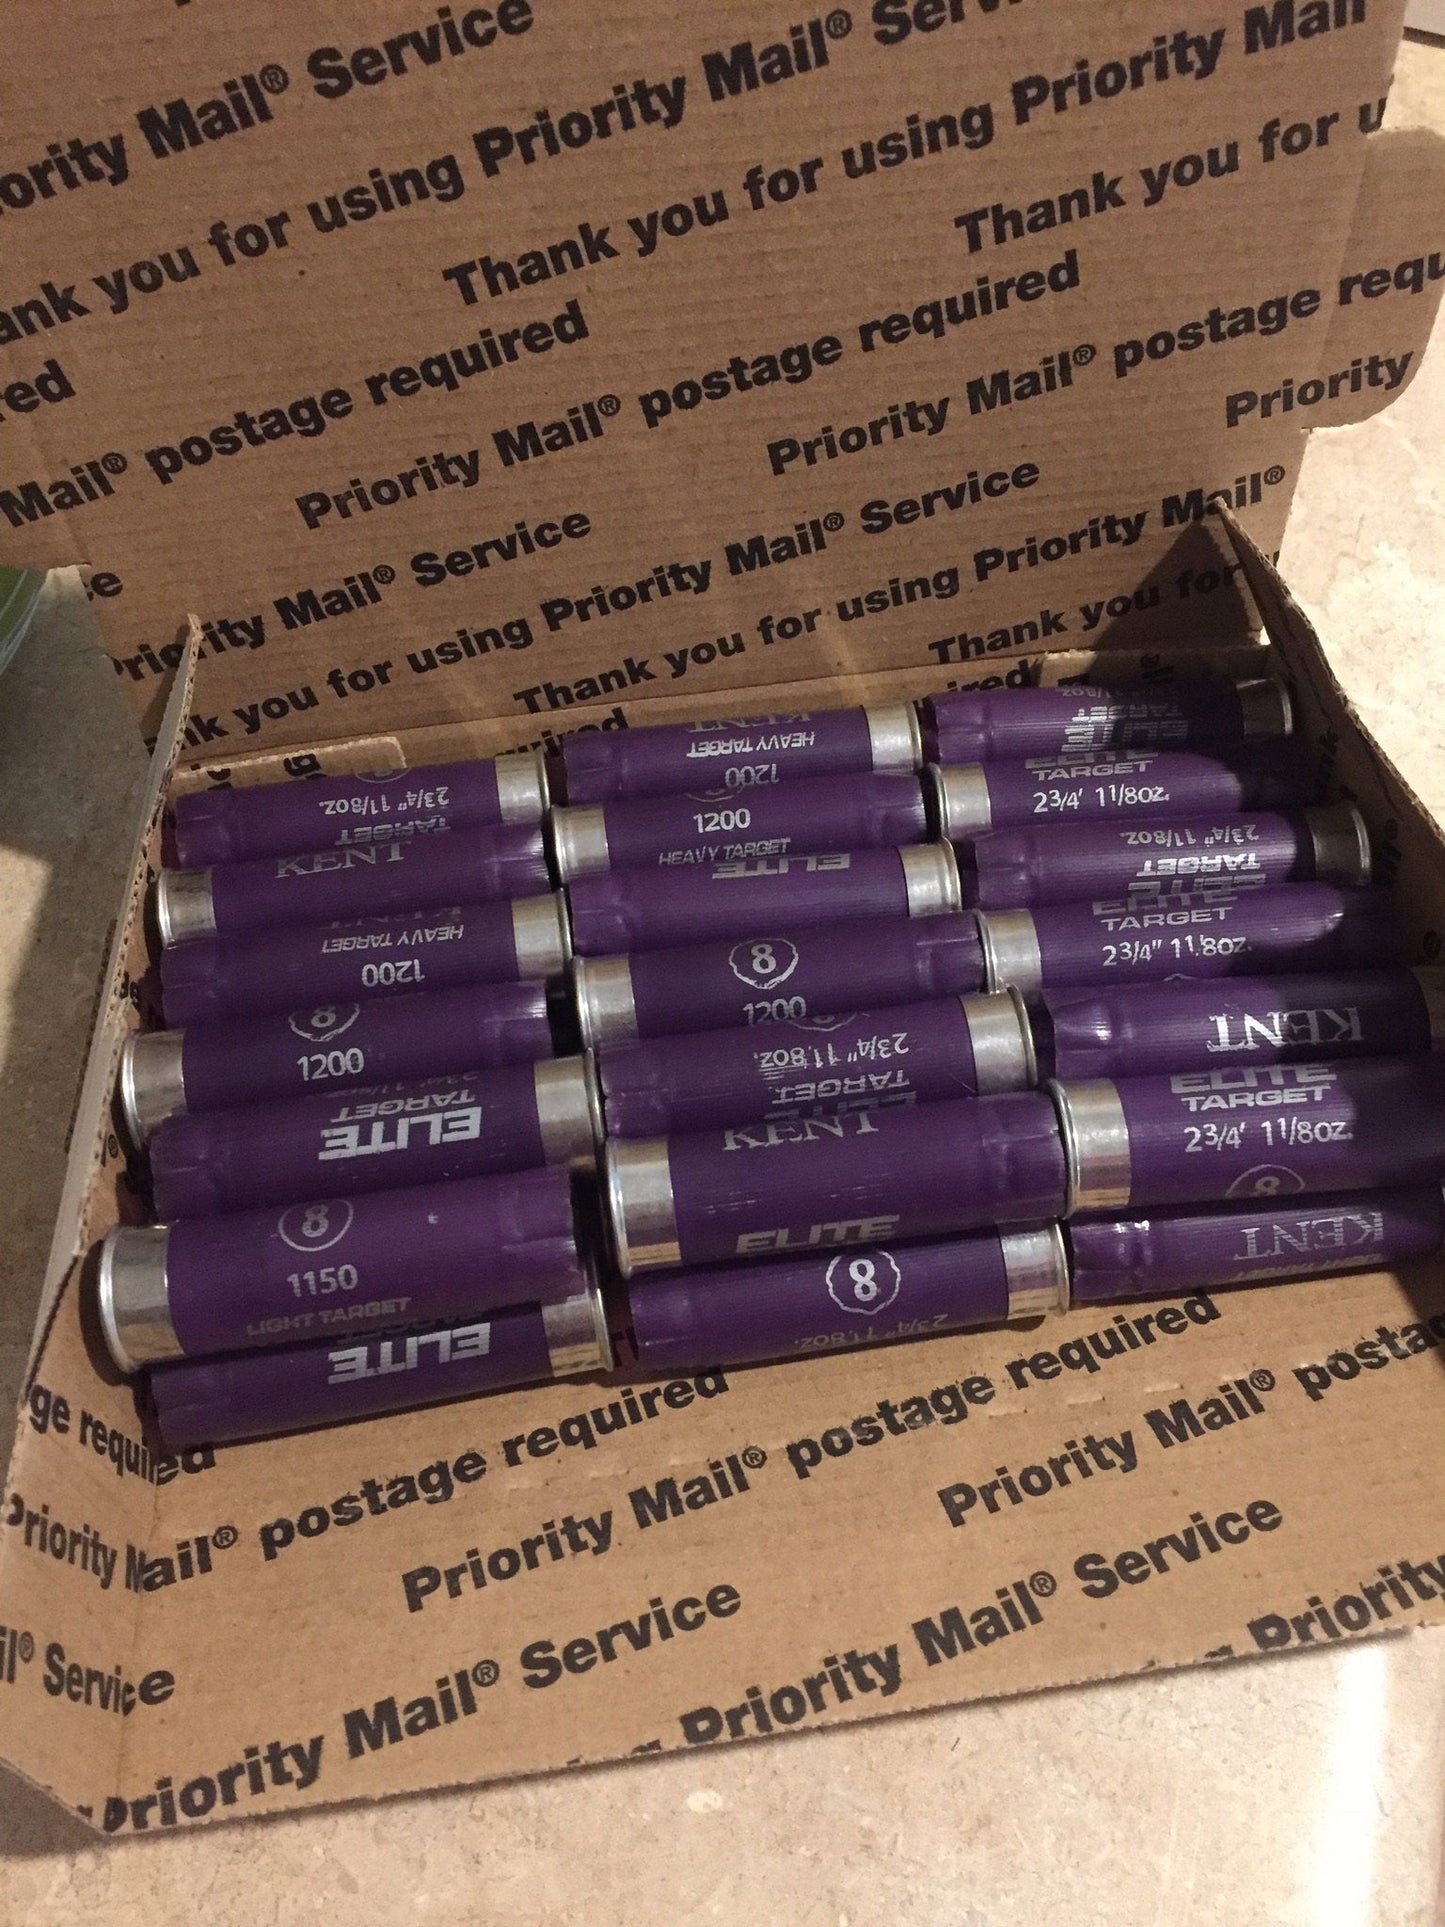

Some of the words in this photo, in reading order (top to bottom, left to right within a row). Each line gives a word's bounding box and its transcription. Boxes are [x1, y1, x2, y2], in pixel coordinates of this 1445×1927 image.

[0, 134, 129, 215] ority
[136, 64, 289, 158] Mail®
[307, 0, 533, 98] Service
[93, 247, 200, 314] you
[208, 211, 292, 266] for
[307, 154, 464, 233] using
[472, 76, 686, 178] Priority
[702, 9, 853, 102] Mail®
[442, 223, 620, 305] Thank
[628, 190, 730, 257] you
[743, 164, 825, 211] for
[842, 103, 994, 179] using
[1011, 28, 1226, 126] Priority
[955, 170, 1127, 254] Thank
[1139, 140, 1239, 207] you
[1258, 112, 1340, 163] for
[296, 448, 480, 529] Priority
[492, 394, 621, 467] Mail®
[638, 335, 843, 429] postage
[858, 249, 1080, 352] required
[767, 396, 950, 476] Priority
[966, 344, 1097, 415] Mail®
[1114, 288, 1321, 379] postage
[1226, 351, 1414, 428] Priority
[0, 452, 128, 527] Mail®
[145, 386, 354, 485] postage
[365, 299, 590, 405] required
[112, 615, 266, 681] rioity
[273, 564, 396, 631] Mail®
[410, 512, 591, 586] Service
[232, 685, 319, 735] you
[327, 660, 394, 698] for
[406, 618, 534, 675] using
[540, 559, 711, 632] Priority
[724, 511, 845, 577] Mail®
[860, 462, 1040, 534] Service
[513, 658, 657, 714] Thank
[664, 631, 745, 679] you
[757, 607, 821, 645] for
[836, 564, 959, 622] using
[974, 509, 1148, 582] Priority
[1162, 464, 1286, 528] Mail®
[929, 610, 1068, 664] Thank
[1081, 582, 1159, 631] you
[1175, 562, 1244, 598] for
[686, 737, 753, 759] TARGET
[756, 731, 816, 751] HEAVY
[724, 762, 780, 789] 1200
[1032, 760, 1153, 782] TARGET
[334, 815, 451, 846] TARGET
[693, 807, 751, 833] 1200
[275, 841, 411, 878] KENT
[658, 845, 721, 867] HEAVY
[723, 837, 791, 860] TARGET
[712, 852, 852, 879] ELITE
[1137, 851, 1261, 877] TARGET
[398, 924, 465, 947] HEAVY
[1101, 907, 1233, 931] TARGET
[320, 933, 393, 954] TARGET
[751, 943, 777, 974] 8
[361, 959, 425, 987] 1200
[743, 995, 807, 1027] 1200
[1207, 1007, 1364, 1052] KENT
[296, 1048, 364, 1082] 1200
[1170, 1062, 1337, 1094] ELITE
[330, 1089, 476, 1123] TARGET
[771, 1069, 911, 1105] TARGET
[1181, 1085, 1331, 1111] TARGET
[318, 1107, 483, 1161] ELITE
[723, 1112, 880, 1150] KENT
[301, 1206, 329, 1237] 8
[735, 1214, 900, 1254] ELITE
[1233, 1212, 1384, 1261] KENT
[286, 1263, 359, 1297] 1150
[849, 1258, 878, 1302] 8
[247, 1312, 313, 1336] LIGHT
[318, 1297, 411, 1327] TARGET
[327, 1322, 492, 1385] ELITE
[260, 1449, 488, 1561] postage
[503, 1364, 730, 1468] required
[402, 1510, 613, 1613] Priority
[628, 1445, 767, 1529] Mail®
[786, 1372, 995, 1480] postage
[1005, 1291, 1221, 1390] required
[937, 1430, 1139, 1527] Priority
[1144, 1368, 1276, 1449] Mail®
[680, 1643, 902, 1745] Priority
[912, 1570, 1057, 1666] Mail®
[1073, 1499, 1283, 1599] Service
[1247, 1553, 1445, 1652] Priorit
[43, 1643, 175, 1716] Service
[344, 1659, 500, 1758] Mail®
[519, 1584, 741, 1688] Service
